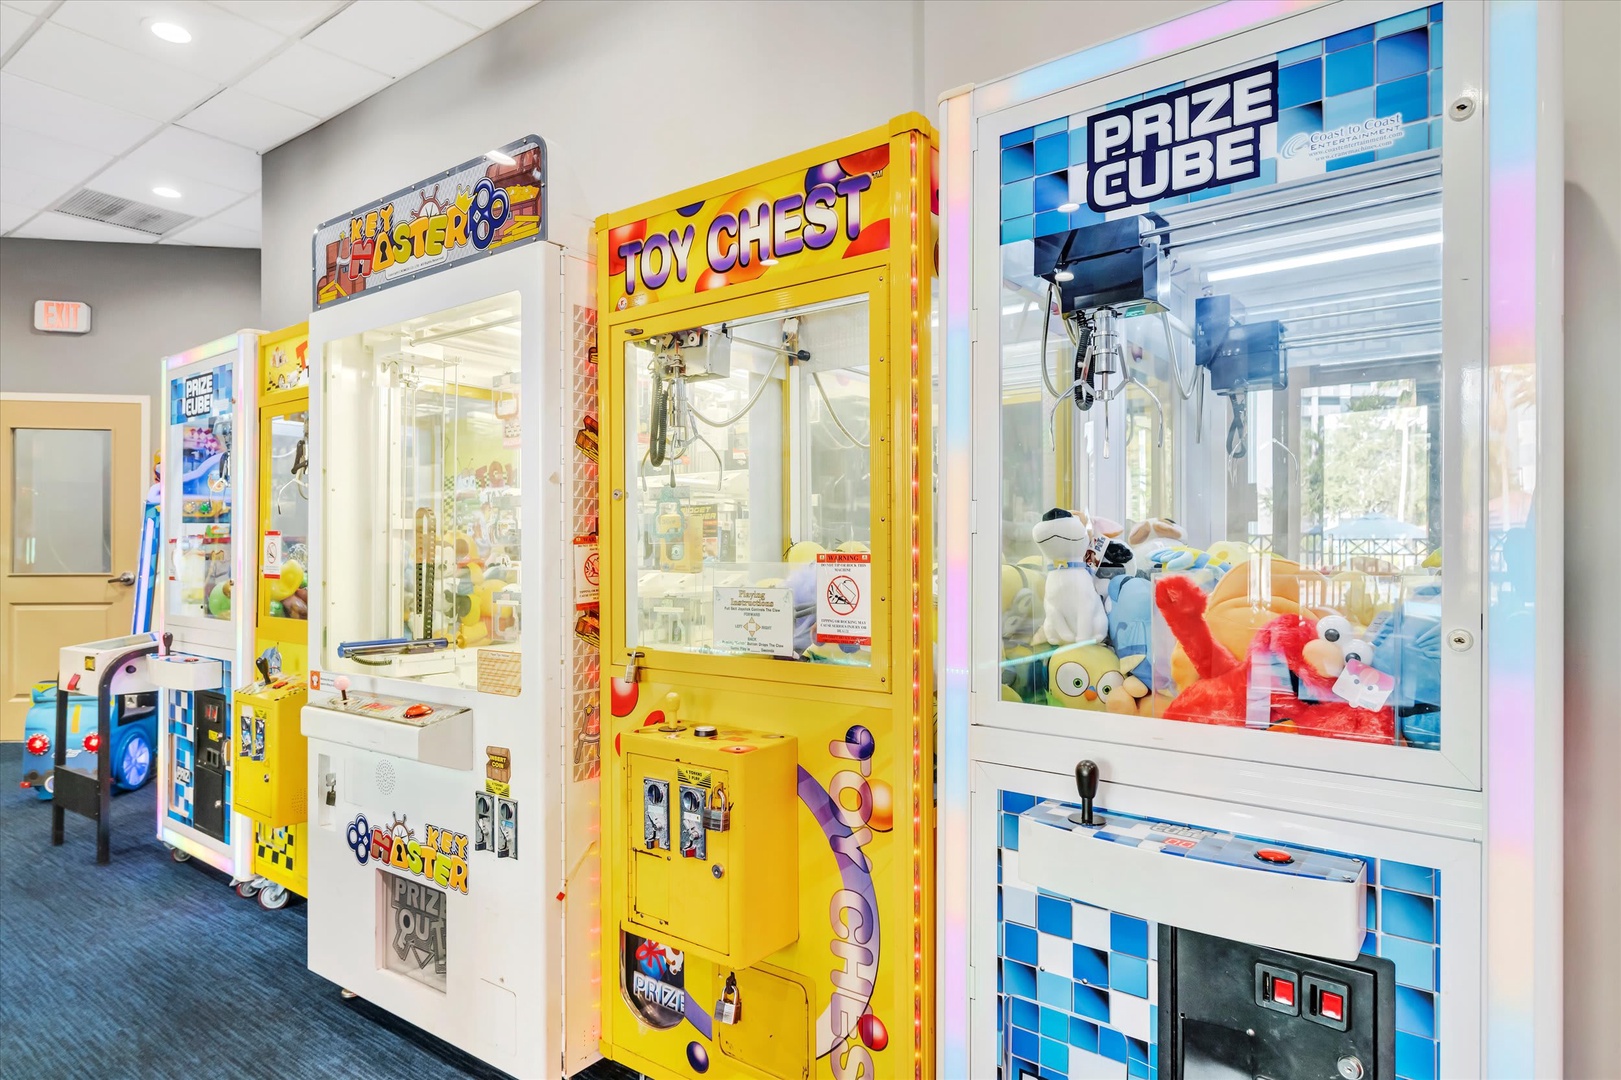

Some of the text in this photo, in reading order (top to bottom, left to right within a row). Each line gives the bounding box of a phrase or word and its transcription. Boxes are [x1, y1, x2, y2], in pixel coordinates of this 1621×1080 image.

[1094, 71, 1273, 163] PRIZE
[1310, 114, 1401, 144] Coast to Coast
[1310, 125, 1401, 151] ENTERTAINMENT
[1093, 126, 1255, 207] CUBE
[351, 202, 395, 242] KEY
[618, 224, 695, 295] TOY
[706, 172, 872, 274] CHEST
[348, 204, 469, 280] MASTER
[43, 301, 81, 329] EXIT
[186, 373, 213, 398] PRIZE
[186, 393, 211, 417] CUBE
[730, 598, 775, 608] Instructions
[738, 590, 766, 601] Playing
[490, 755, 507, 763] INSERT
[491, 761, 505, 769] COIN
[829, 728, 874, 874] TOY
[427, 825, 468, 859] KEY
[370, 829, 469, 894] MASTER
